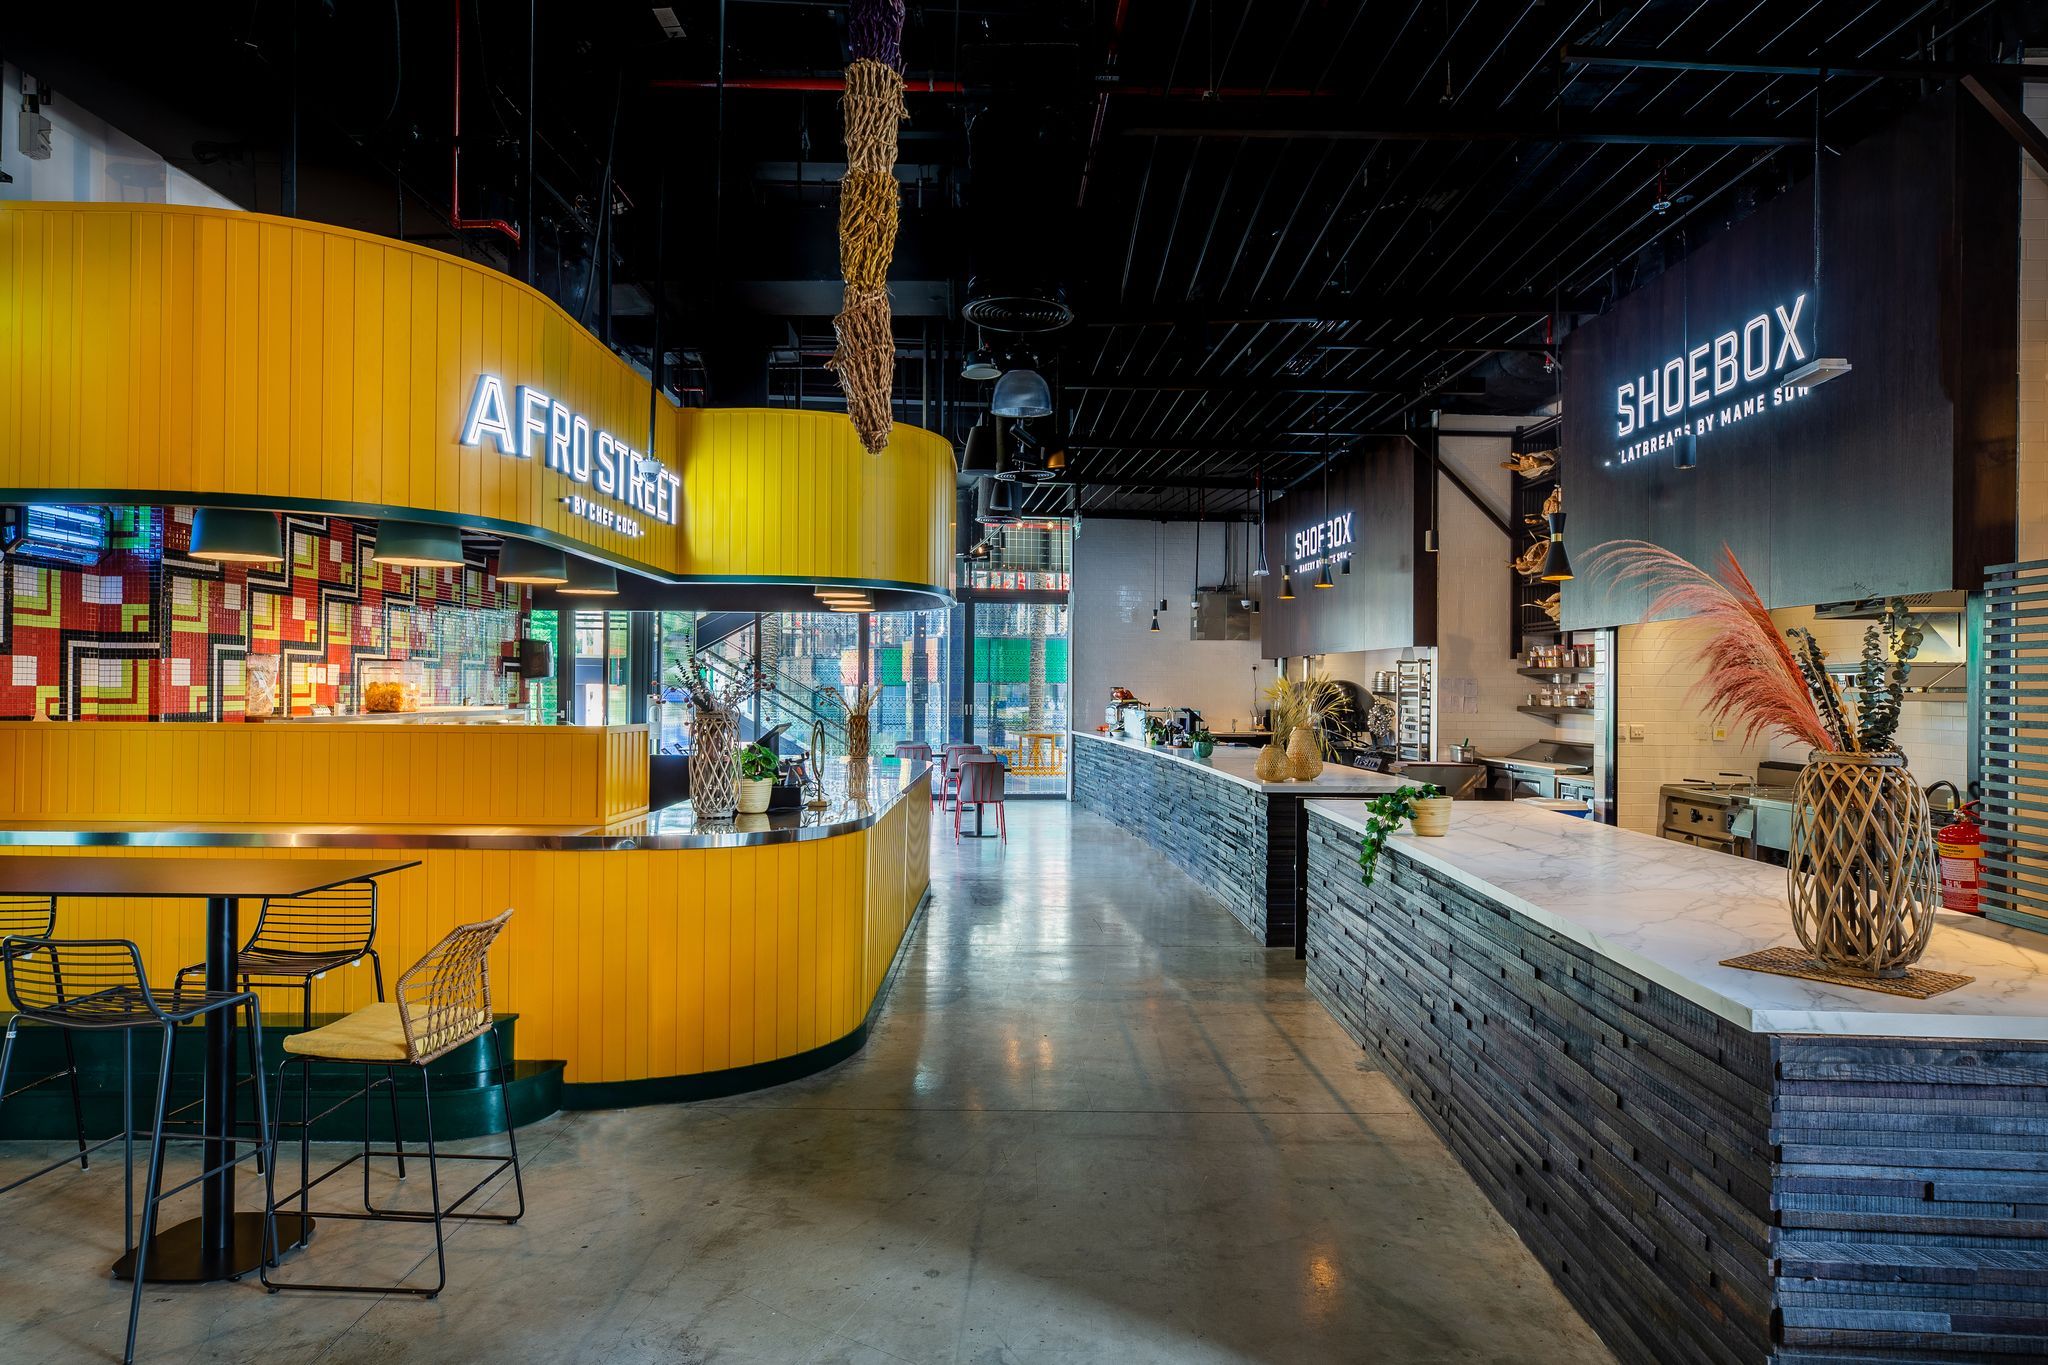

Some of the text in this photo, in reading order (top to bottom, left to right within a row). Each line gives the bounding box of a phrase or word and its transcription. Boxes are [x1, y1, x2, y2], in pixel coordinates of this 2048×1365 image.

[1618, 294, 1806, 437] SHOEBOX
[1697, 414, 1715, 435] BY
[1721, 394, 1765, 427] MAME
[461, 374, 681, 525] AFRO STREET
[570, 495, 638, 537] BY CHEF COCO
[1295, 512, 1352, 560] SHOEBOX
